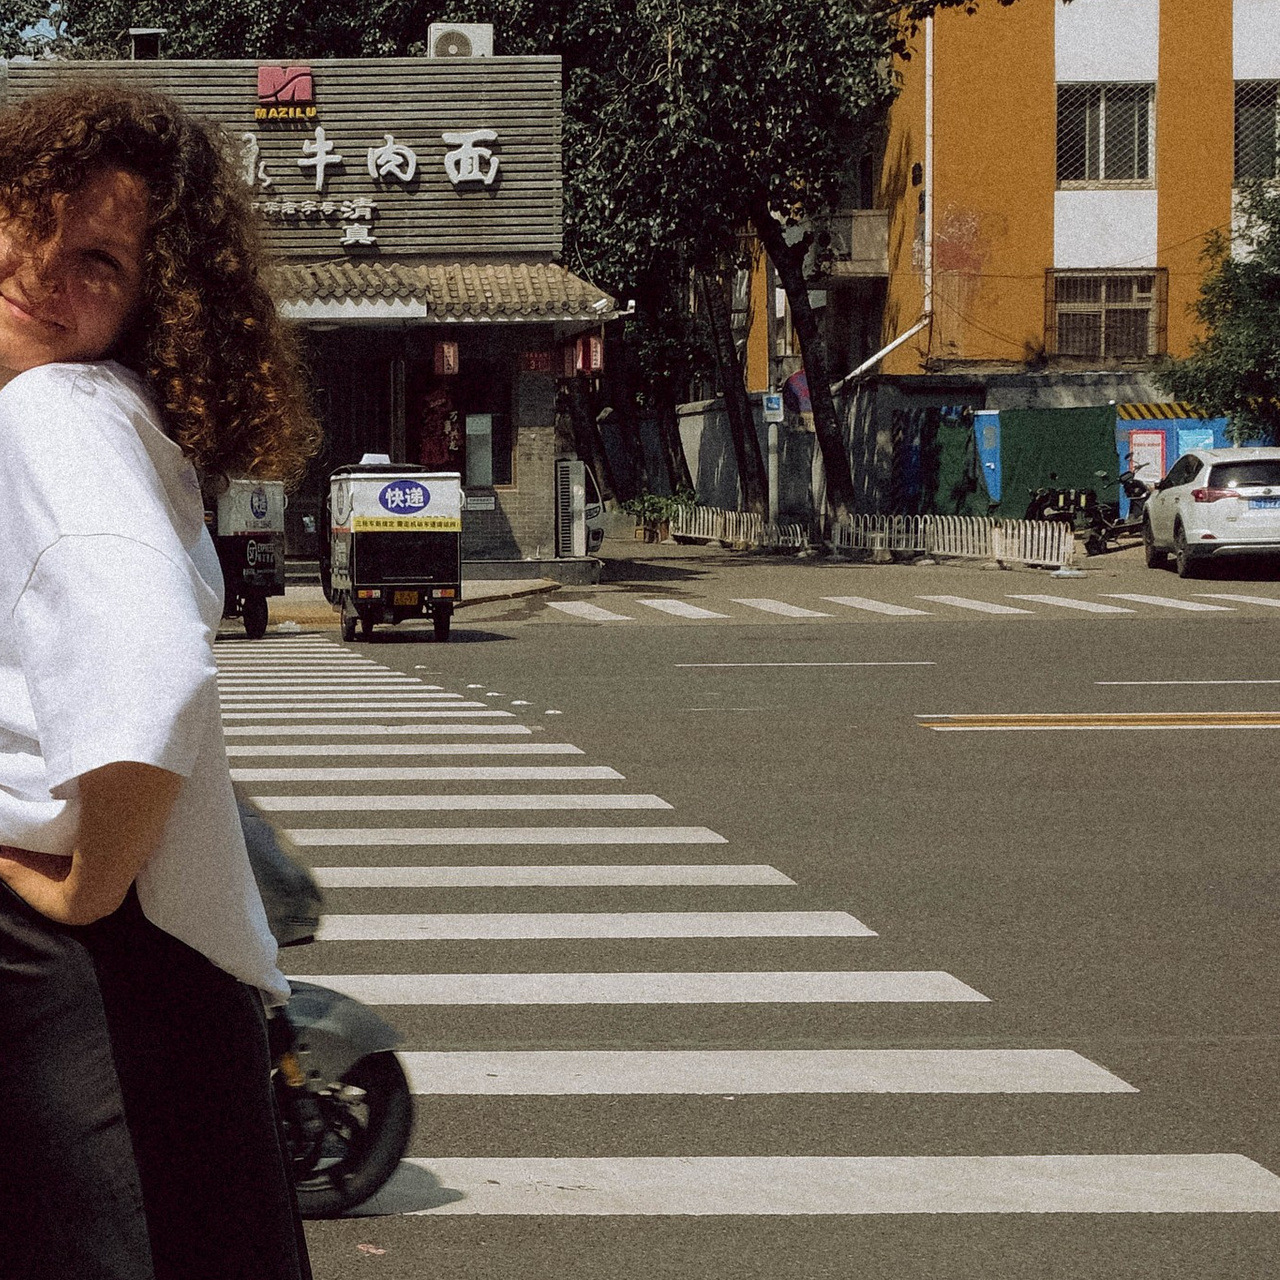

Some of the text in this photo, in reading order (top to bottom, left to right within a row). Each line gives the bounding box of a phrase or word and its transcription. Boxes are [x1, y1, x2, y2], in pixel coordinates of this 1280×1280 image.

[254, 106, 317, 120] MAZILU
[339, 197, 378, 246] 清真
[385, 487, 424, 508] 快递
